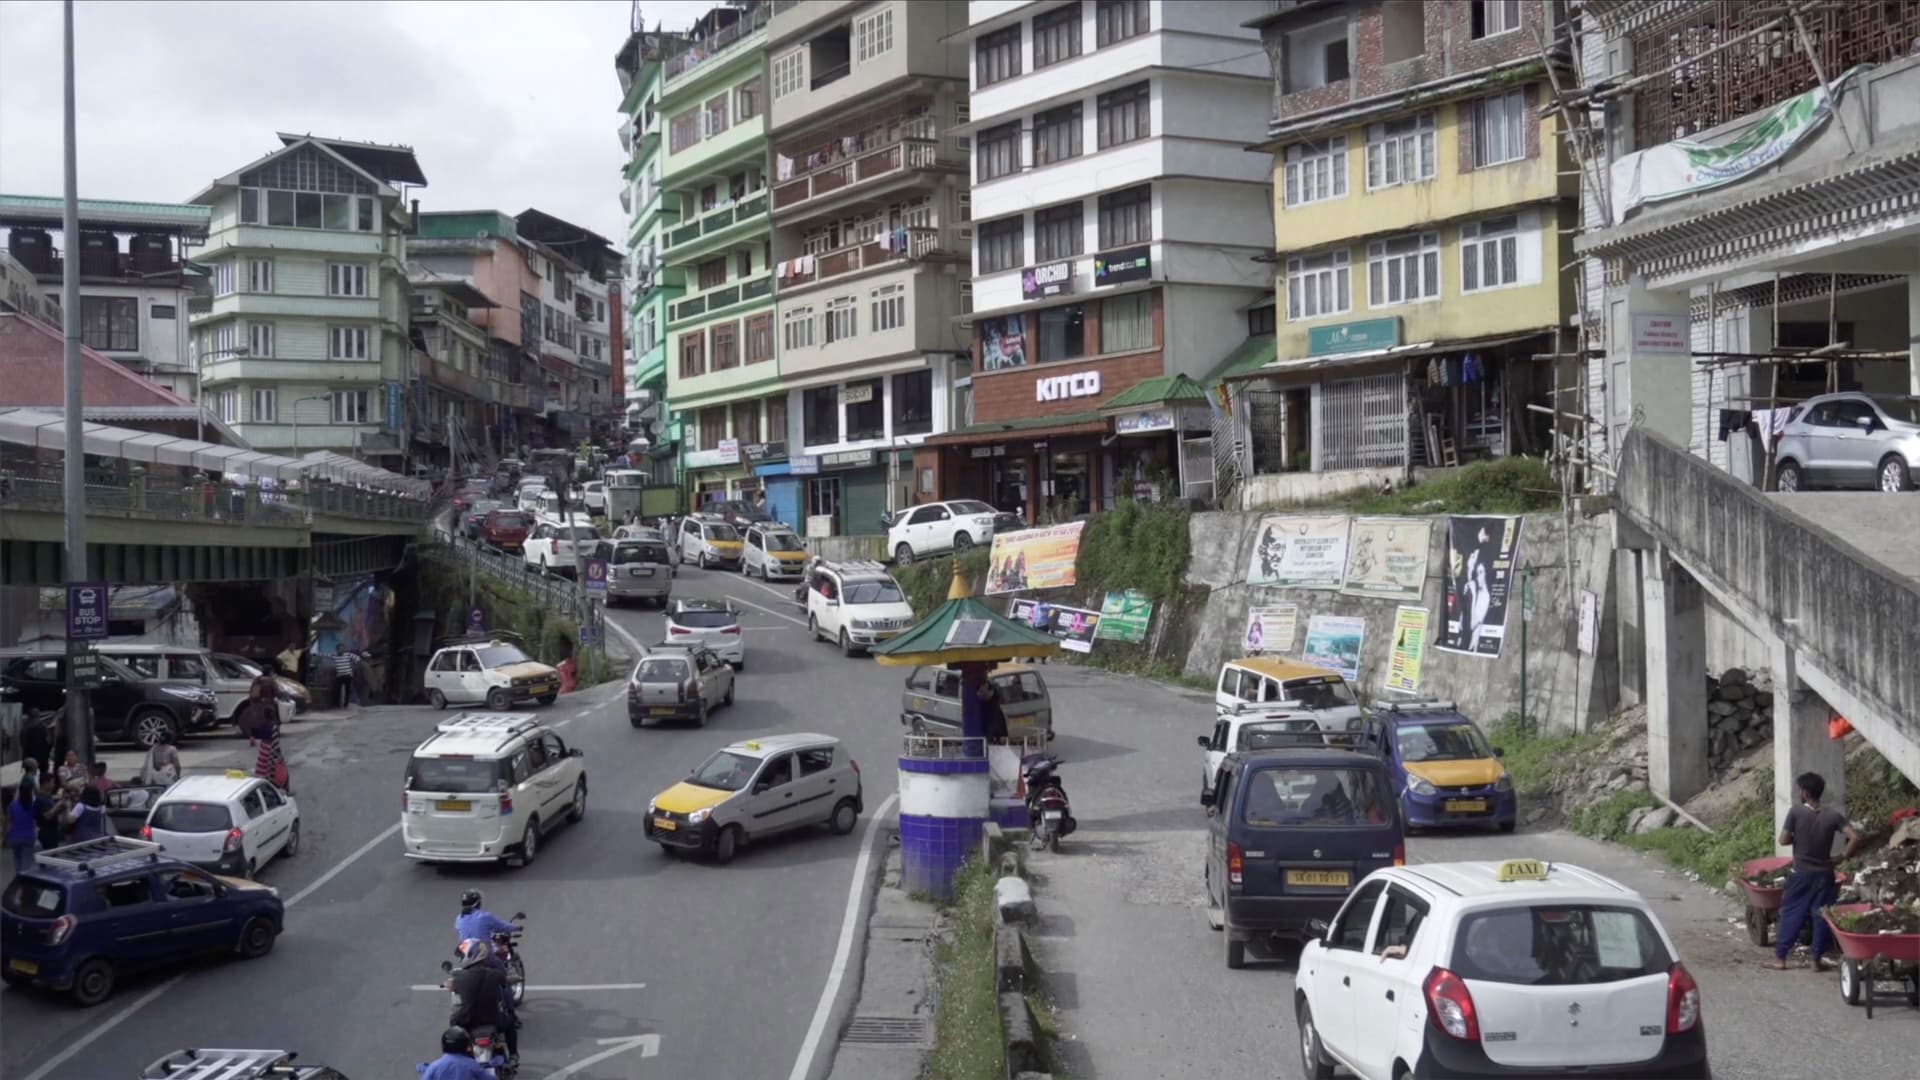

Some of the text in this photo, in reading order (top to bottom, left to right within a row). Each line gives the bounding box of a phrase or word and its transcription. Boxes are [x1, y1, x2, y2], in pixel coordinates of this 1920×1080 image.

[1035, 263, 1069, 285] ORCHID
[1036, 371, 1101, 402] KITCO
[79, 608, 96, 616] BUS
[75, 616, 101, 625] STOP
[1506, 863, 1540, 875] TAXI
